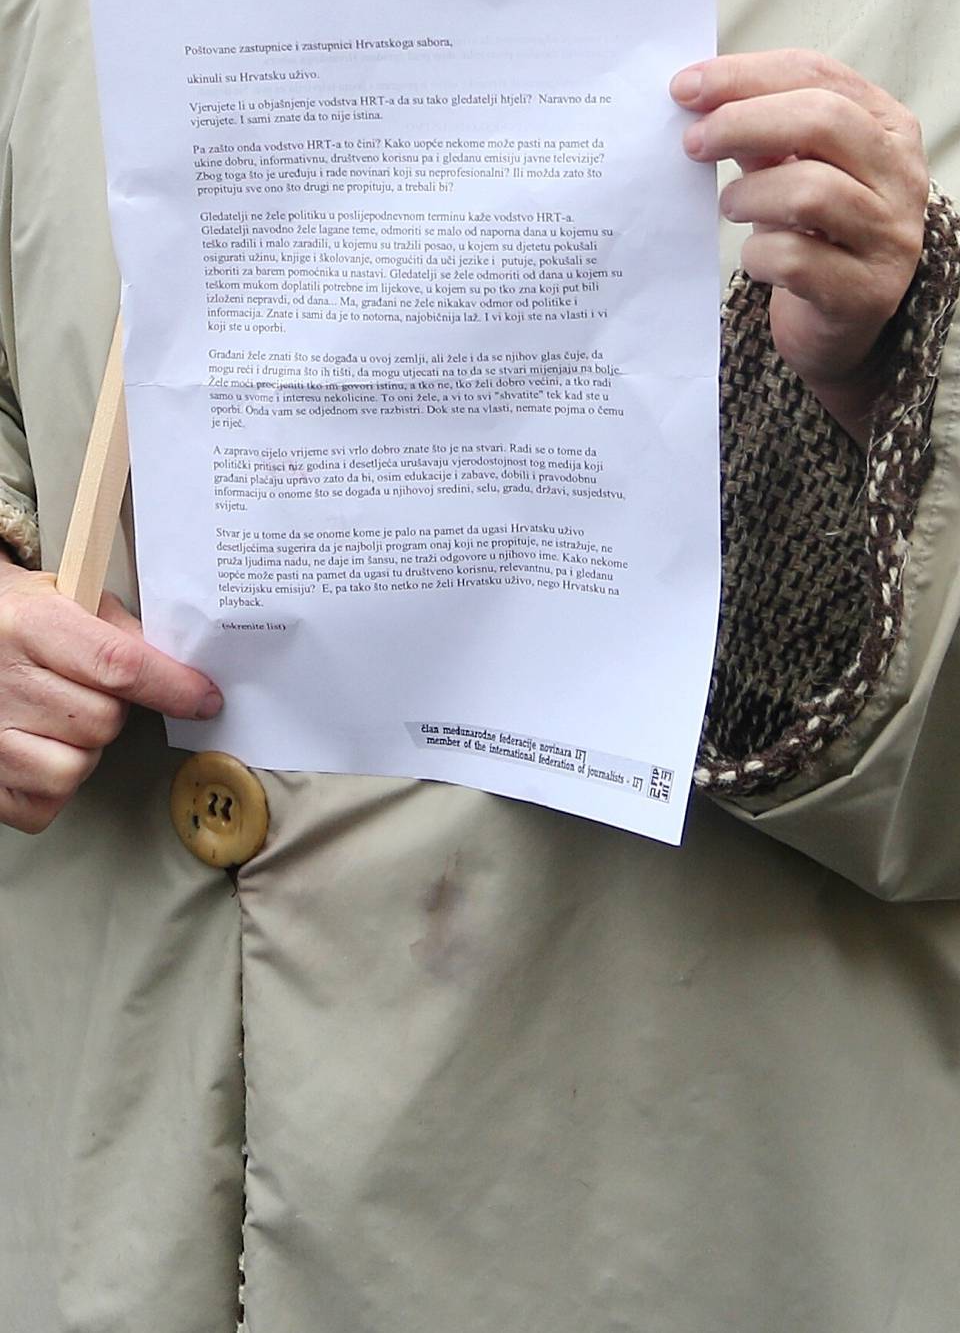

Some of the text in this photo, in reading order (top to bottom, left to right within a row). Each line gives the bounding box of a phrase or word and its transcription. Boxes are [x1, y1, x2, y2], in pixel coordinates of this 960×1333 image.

[185, 44, 237, 55] Poštovane
[239, 42, 293, 55] zastupnice
[302, 39, 353, 52] zastupnici
[356, 38, 415, 50] Hrvatskoga
[417, 37, 453, 47] sabora,
[187, 73, 222, 84] ukinuli
[240, 70, 286, 82] Hrvatsku
[289, 68, 319, 79] uživo.
[190, 101, 236, 114] Vjerujete
[239, 100, 246, 111] li
[258, 97, 317, 112] objašnjenje
[318, 96, 359, 107] vodstva
[360, 95, 395, 106] HRT-a
[397, 95, 410, 105] da
[413, 97, 424, 105] su
[427, 94, 448, 104] tako
[452, 93, 498, 107] gledatelji
[501, 93, 532, 105] htjeli?
[539, 93, 582, 103] Naravno
[584, 93, 597, 103] da
[191, 113, 238, 128] vjerujete.
[247, 112, 271, 124] sami
[274, 110, 302, 123] znate
[303, 110, 317, 121] da
[318, 109, 329, 121] to
[331, 109, 351, 122] nije
[353, 109, 383, 120] istina.
[193, 145, 207, 154] Pa
[208, 144, 235, 154] zašto
[237, 142, 262, 153] onda
[264, 140, 306, 152] vodstvo
[307, 139, 342, 150] HRT-a
[344, 139, 355, 149] to
[357, 138, 383, 149] čini?
[385, 138, 411, 148] Kako
[414, 138, 444, 150] uopće
[446, 138, 485, 148] nekome
[488, 139, 515, 148] može
[518, 139, 541, 151] pasti
[559, 139, 589, 151] pamet
[592, 138, 604, 148] da
[194, 156, 224, 168] ukine
[224, 154, 259, 168] dobru,
[260, 152, 329, 166] informativnu,
[331, 151, 380, 163] društveno
[382, 151, 419, 163] korisnu
[422, 155, 434, 165] pa
[443, 152, 482, 165] gledanu
[484, 152, 521, 165] emisiju
[524, 153, 551, 165] javne
[553, 152, 604, 165] televizije?
[196, 169, 224, 183] Zbog
[225, 169, 247, 183] toga
[249, 168, 265, 179] što
[266, 167, 277, 181] je
[278, 166, 318, 181] uređuju
[326, 166, 348, 177] rade
[350, 165, 392, 177] novinari
[393, 165, 413, 179] koji
[415, 169, 427, 177] su
[429, 166, 510, 179] neprofesionalni?
[513, 167, 524, 177] Ili
[526, 167, 560, 177] možda
[563, 168, 584, 177] zato
[587, 166, 602, 177] što
[198, 182, 243, 196] propituju
[245, 184, 263, 193] sve
[264, 184, 285, 192] ono
[286, 181, 302, 192] što
[303, 180, 331, 194] drugi
[332, 183, 345, 191] ne
[347, 180, 395, 193] propituju,
[405, 179, 436, 191] trebali
[439, 179, 453, 190] bi?
[200, 211, 250, 223] Gledatelji
[251, 213, 264, 221] ne
[265, 211, 287, 221] žele
[288, 209, 327, 223] politiku
[338, 210, 425, 223] poslijepodnevnom
[428, 211, 465, 221] terminu
[468, 211, 491, 222] kaže
[494, 211, 534, 222] vodstvo
[536, 212, 574, 223] HRT-a.
[208, 319, 226, 333] koji
[229, 319, 242, 331] ste
[252, 320, 286, 333] oporbi.
[212, 416, 245, 429] je riječ.
[214, 457, 251, 472] politički
[254, 459, 286, 473] pritisci
[288, 459, 306, 471] niz
[307, 459, 341, 473] godina
[349, 456, 399, 472] desetljeća
[400, 455, 450, 470] urušavaju
[450, 454, 529, 469] vjerodostojnost
[530, 456, 546, 470] tog
[548, 457, 583, 473] medija
[584, 459, 603, 474] koji
[215, 499, 248, 512] svijetu.
[216, 527, 240, 539] Stvar
[243, 529, 251, 542] je
[262, 531, 287, 540] tome
[289, 529, 301, 540] da
[303, 532, 314, 540] se
[316, 531, 352, 539] onome
[353, 527, 382, 538] kome
[384, 527, 393, 540] je
[395, 526, 417, 539] palo
[419, 528, 432, 537] na
[434, 525, 465, 538] pamet
[467, 525, 479, 535] da
[482, 523, 509, 537] ugasi
[511, 523, 556, 535] Hrvatsku
[558, 526, 584, 536] uživo
[219, 594, 263, 609] playback.
[421, 724, 439, 734] član
[500, 733, 537, 750] federacije
[539, 743, 572, 757] novinara
[575, 749, 587, 764] IFJ
[426, 736, 461, 747] member
[463, 740, 471, 749] of
[474, 740, 486, 752] the
[489, 743, 535, 762] international
[538, 754, 575, 771] federation
[577, 764, 585, 773] of
[586, 765, 624, 784] journalists
